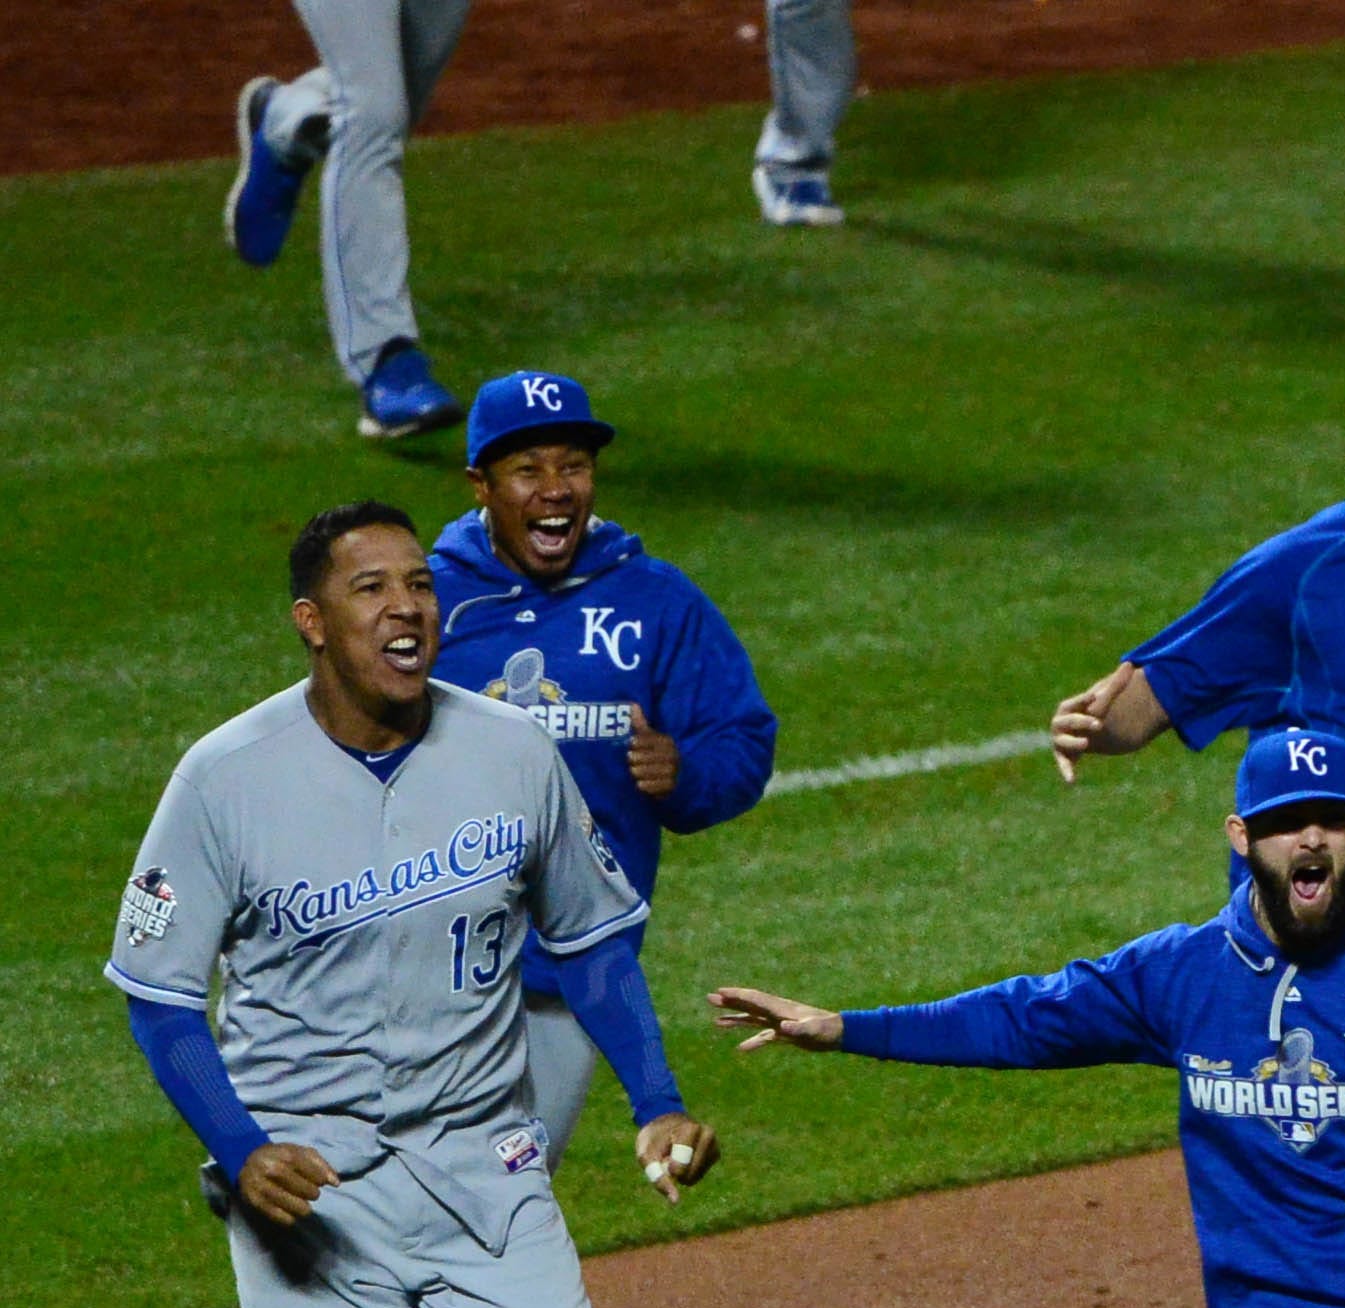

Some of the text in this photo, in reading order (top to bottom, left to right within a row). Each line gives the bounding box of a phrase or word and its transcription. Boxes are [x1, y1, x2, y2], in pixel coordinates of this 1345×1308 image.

[521, 375, 562, 411] KC
[578, 607, 643, 671] KC
[527, 704, 632, 739] SERIES
[1287, 738, 1328, 776] KC
[257, 812, 528, 939] Kansas City
[448, 902, 508, 993] 13
[1187, 1075, 1293, 1117] WORLD
